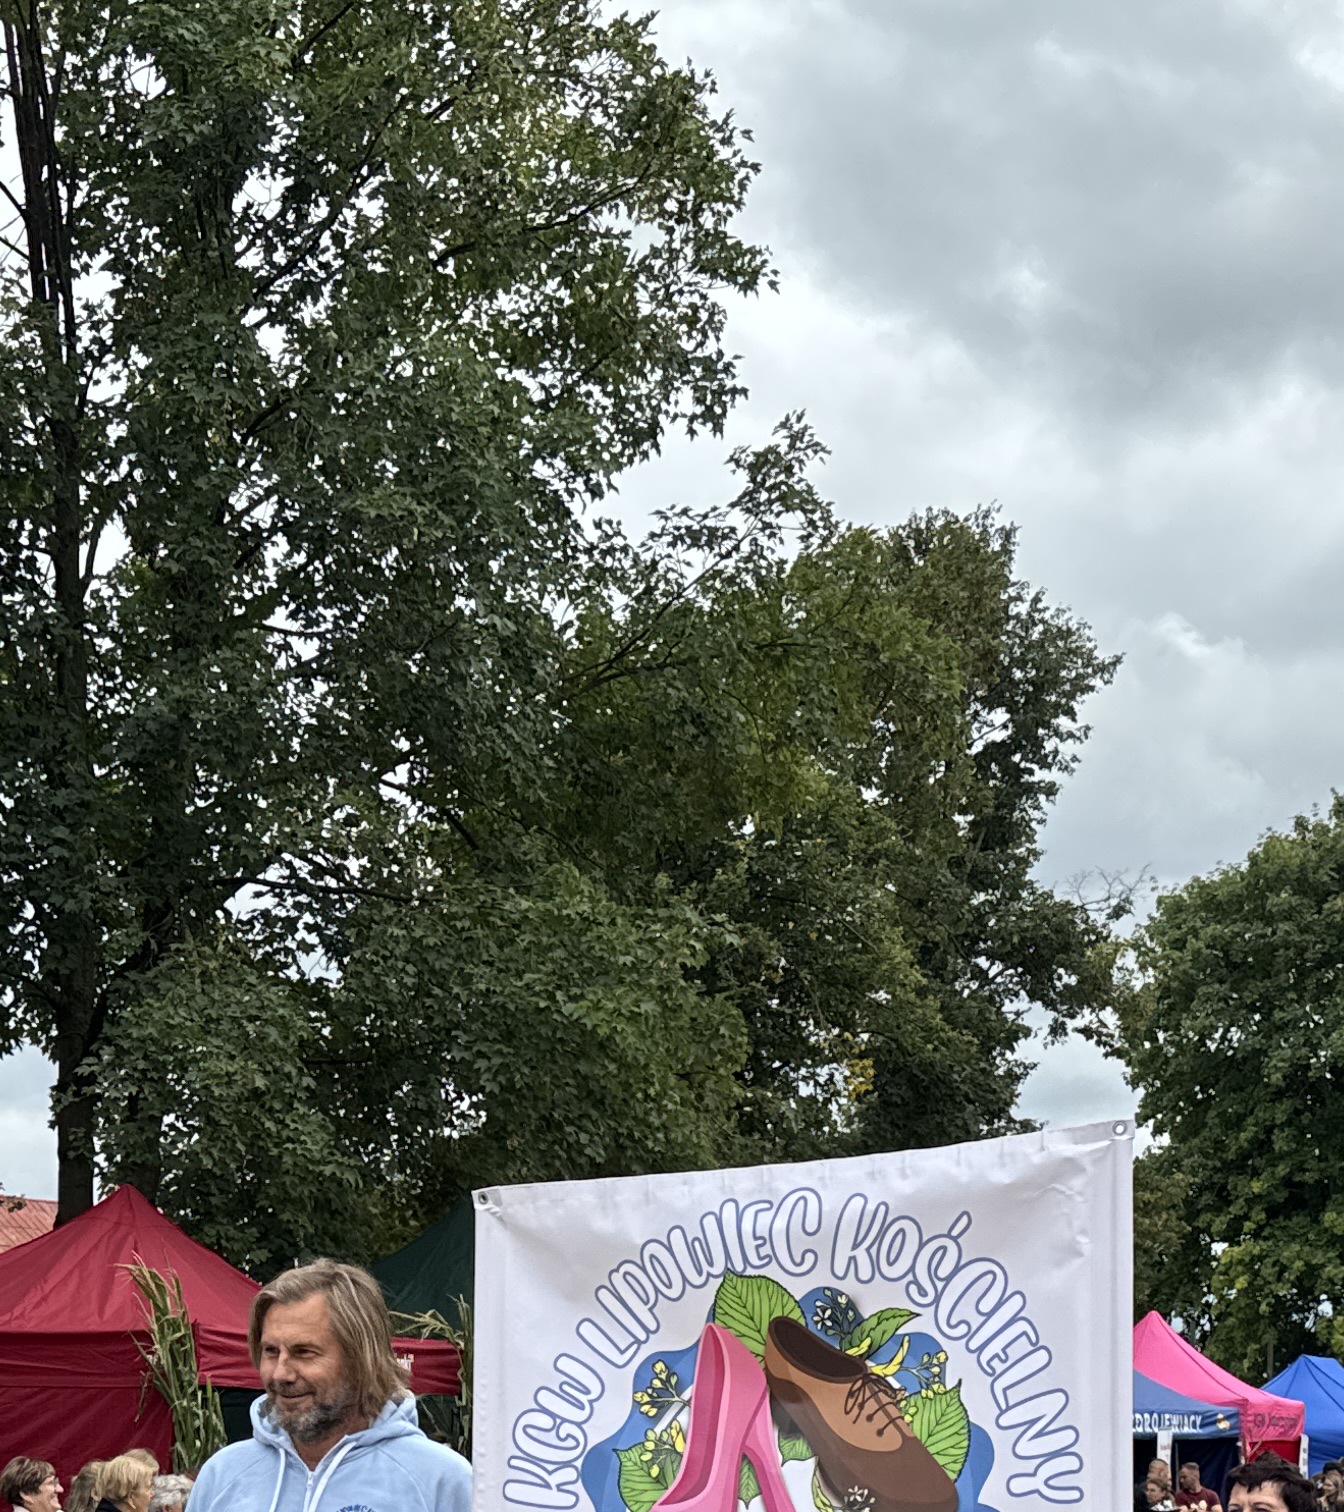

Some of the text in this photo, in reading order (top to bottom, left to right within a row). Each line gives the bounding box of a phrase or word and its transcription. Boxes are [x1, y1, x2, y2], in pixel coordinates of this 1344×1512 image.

[503, 1187, 1084, 1510] KGW LIPOWIEC KOŚCIELNY
